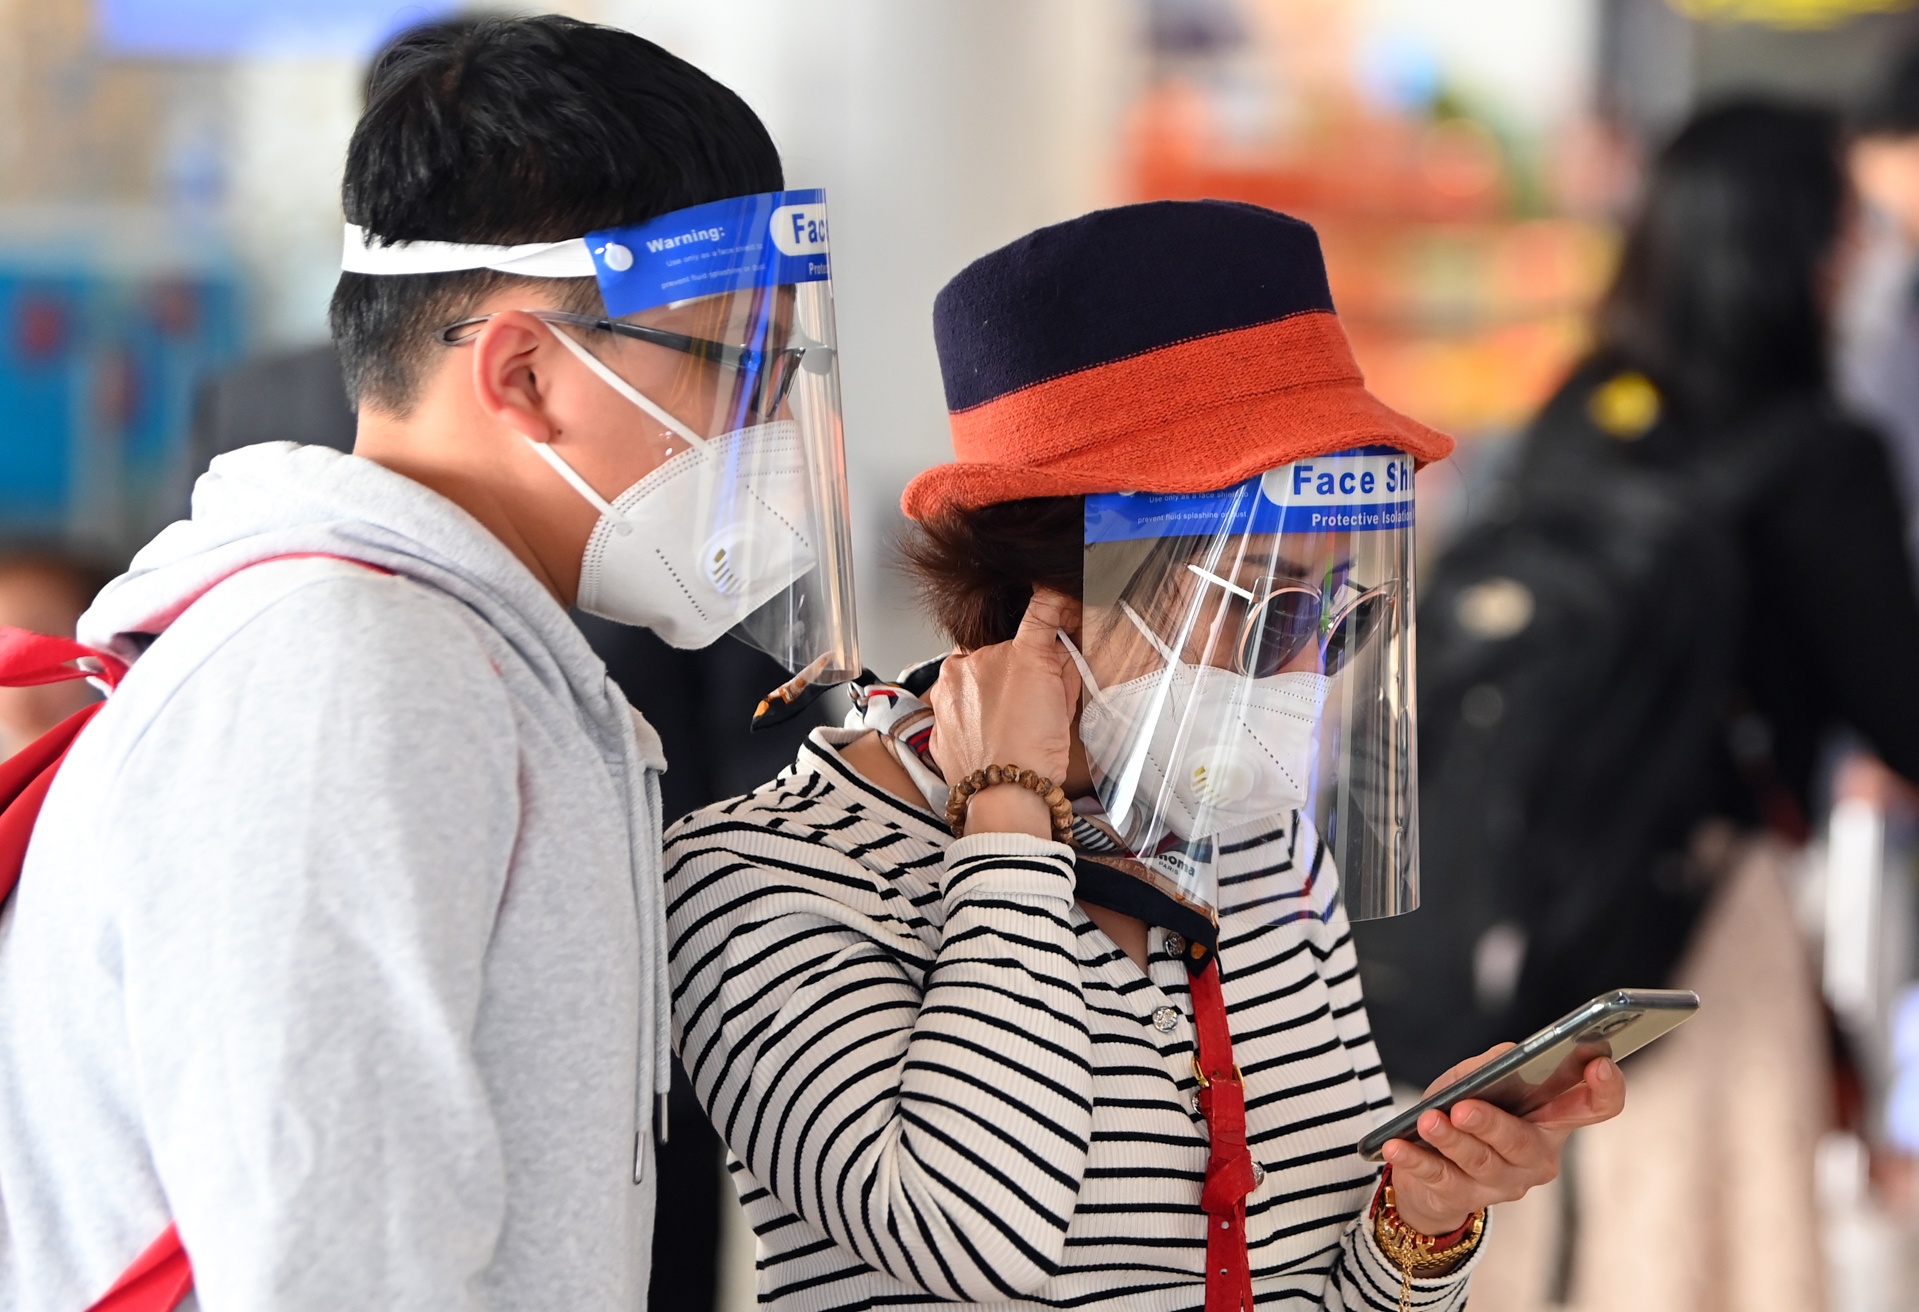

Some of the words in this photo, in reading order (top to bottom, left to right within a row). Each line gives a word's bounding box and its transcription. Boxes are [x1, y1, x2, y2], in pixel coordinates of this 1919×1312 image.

[646, 226, 725, 253] Warning:
[1293, 465, 1375, 495] Face
[1137, 514, 1164, 524] prevent
[1165, 512, 1181, 520] fluid
[1312, 512, 1379, 527] Protective
[1158, 861, 1179, 876] PARIS
